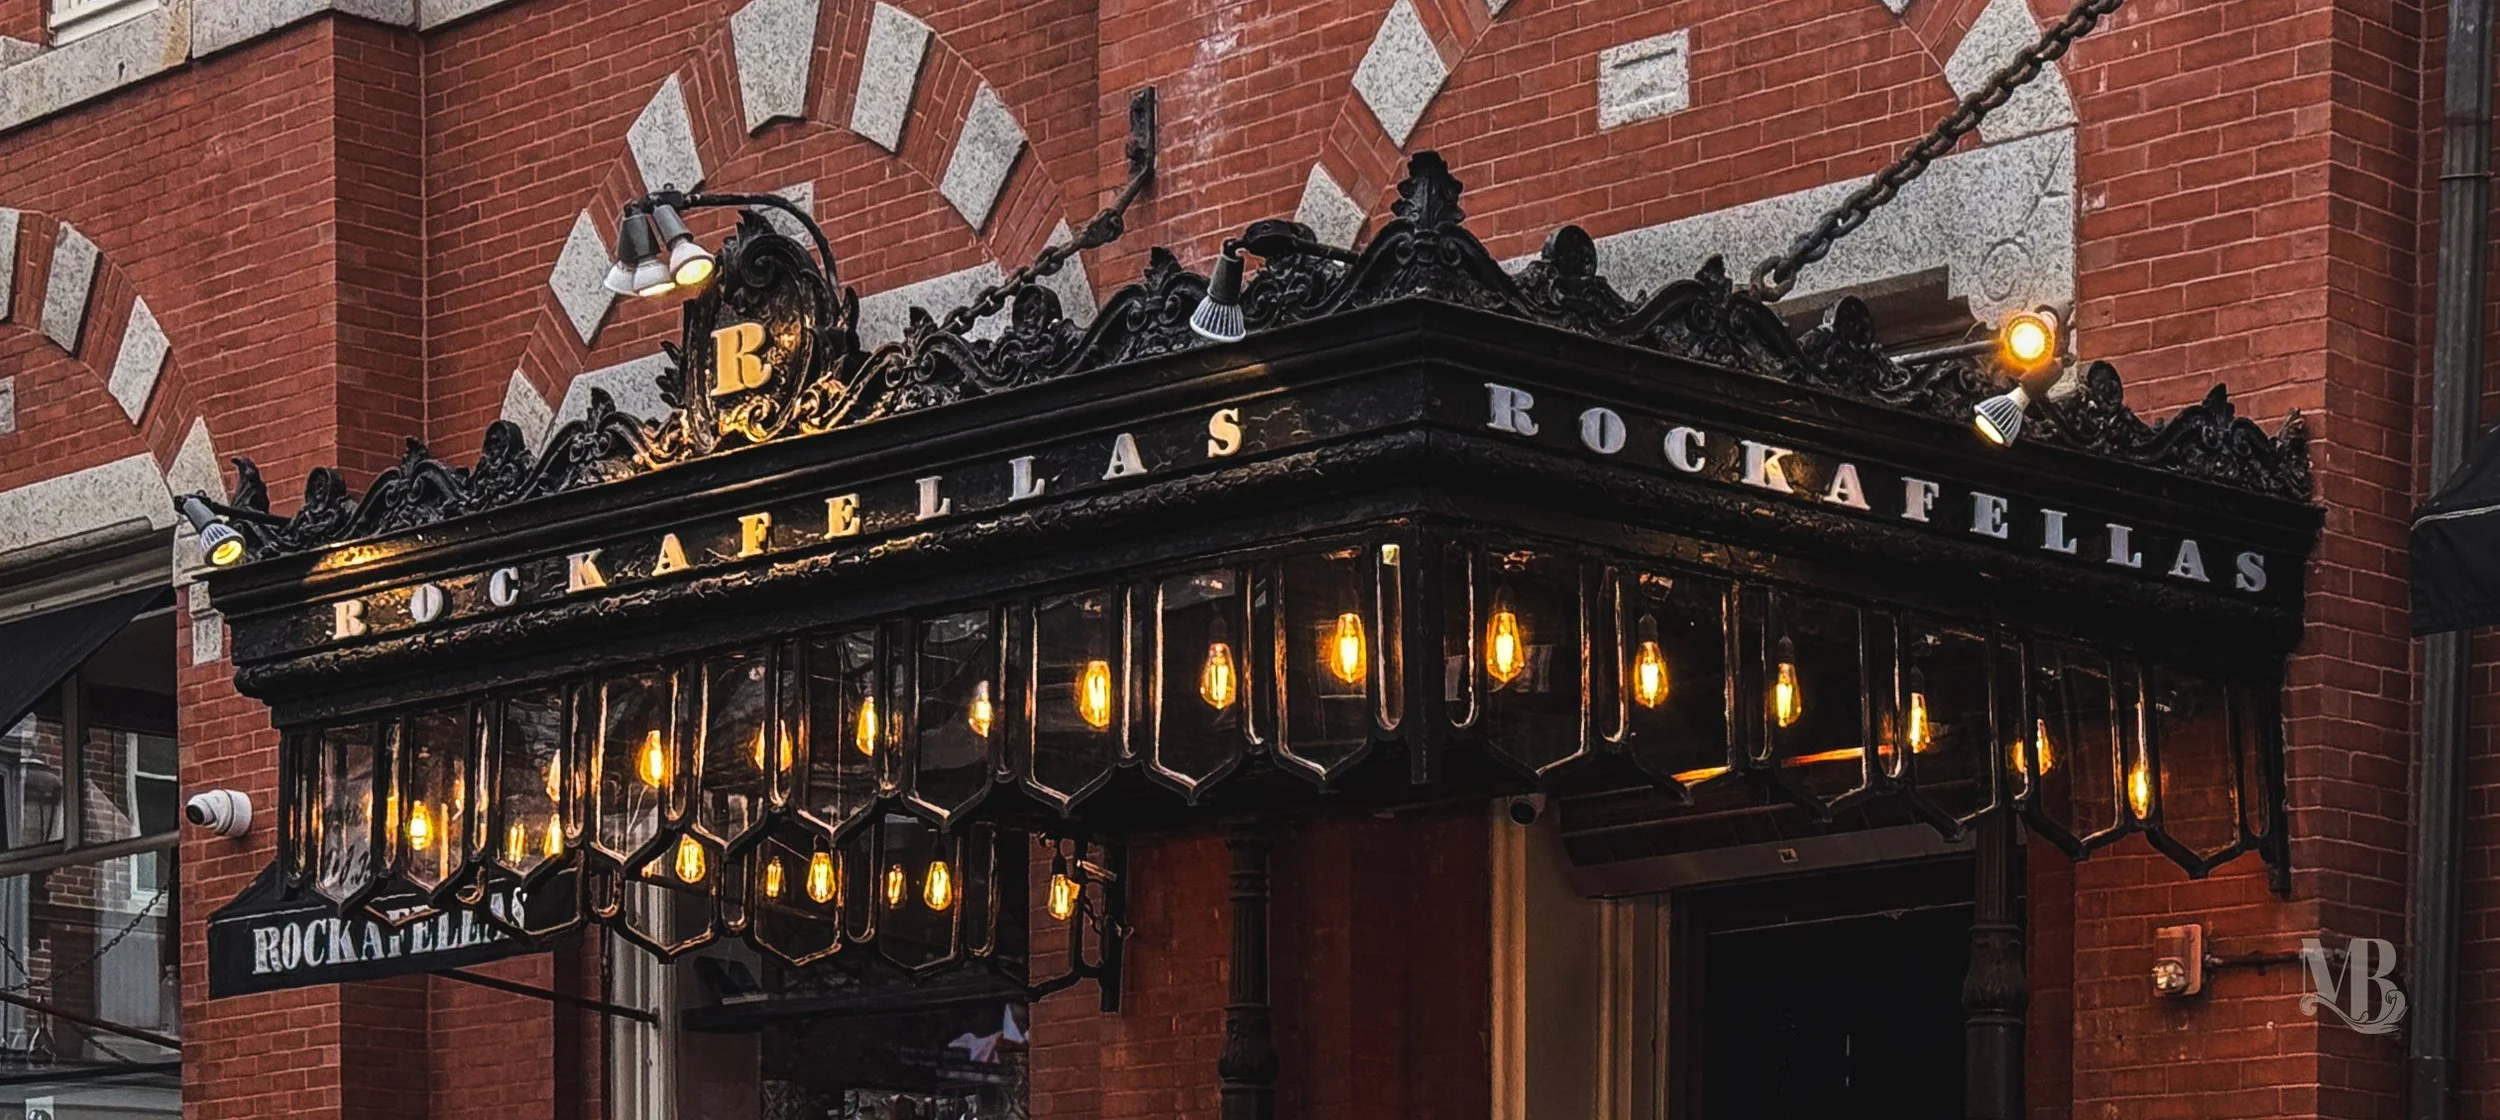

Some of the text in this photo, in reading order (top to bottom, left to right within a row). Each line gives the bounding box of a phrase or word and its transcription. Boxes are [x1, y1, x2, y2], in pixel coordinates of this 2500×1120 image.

[710, 322, 772, 397] R
[332, 407, 1242, 640] ROCKAFELLAS
[1484, 382, 2267, 592] ROCKAFELLAS
